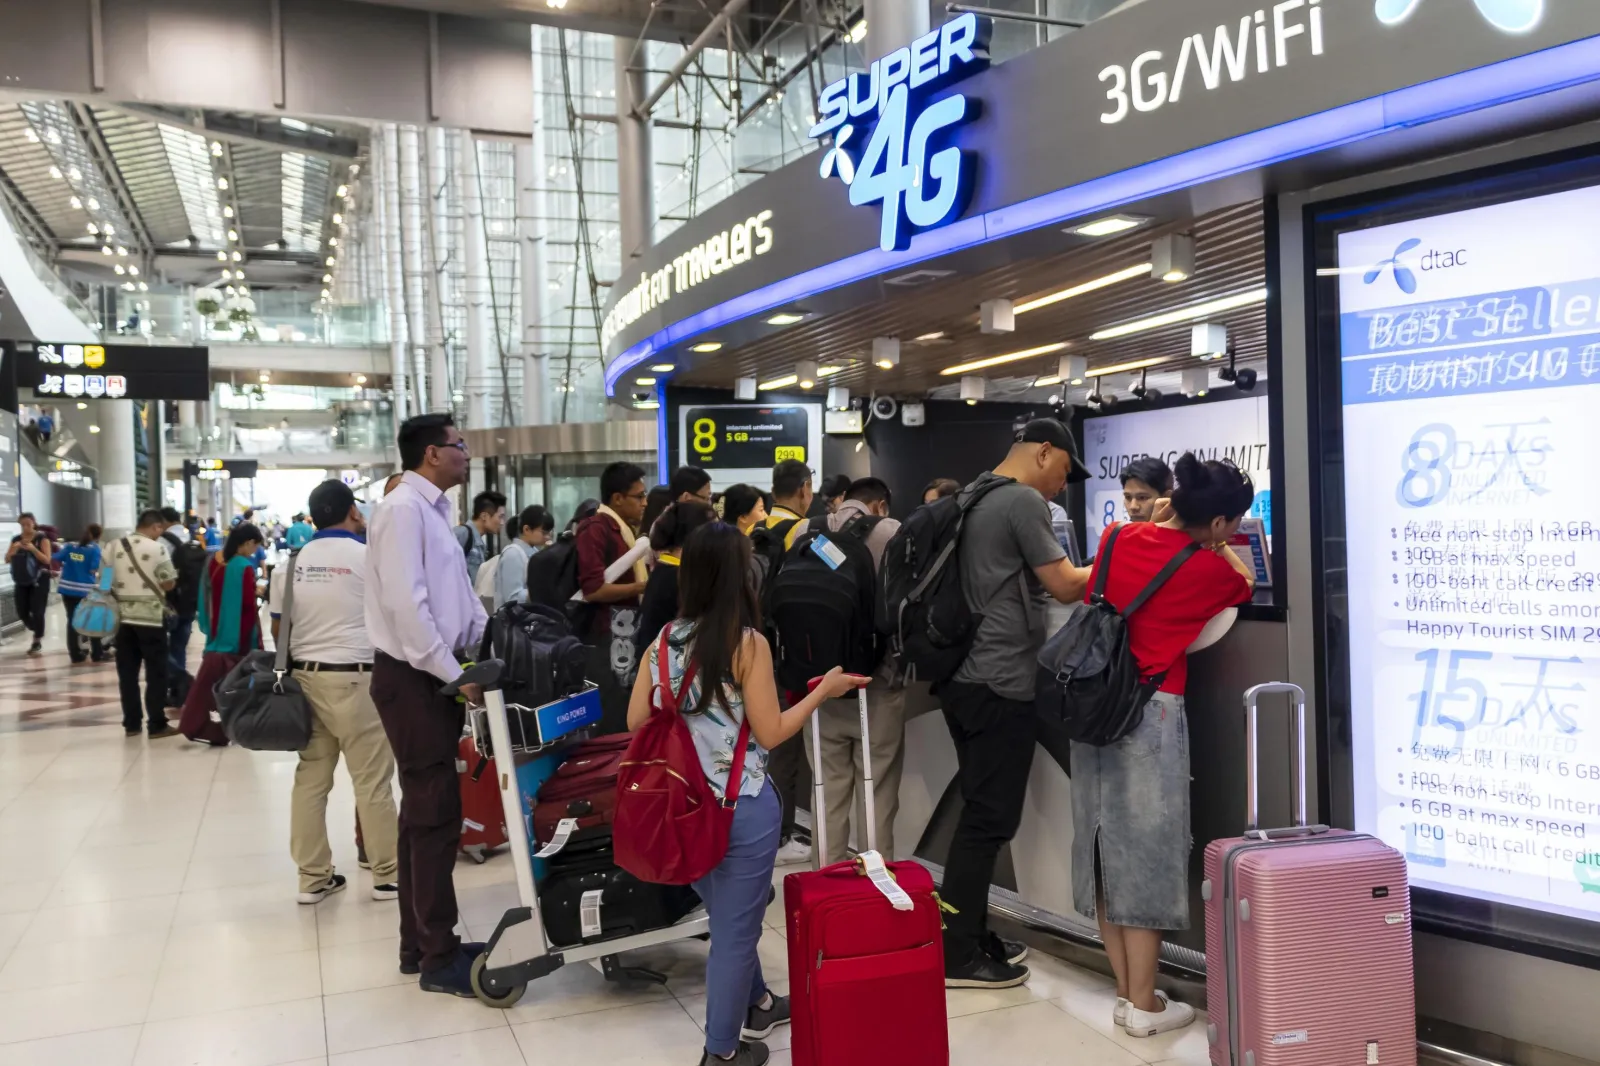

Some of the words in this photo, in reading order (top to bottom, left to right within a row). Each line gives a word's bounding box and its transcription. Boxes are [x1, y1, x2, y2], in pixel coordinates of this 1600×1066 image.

[1098, 0, 1324, 124] 3G/WiFi
[808, 12, 976, 138] SUPER
[849, 83, 966, 251] 4G
[1420, 248, 1467, 271] dtac
[693, 418, 717, 454] 8
[726, 432, 733, 443] 5
[734, 432, 749, 443] GB
[752, 423, 783, 431] unlimited
[1103, 500, 1115, 528] 8
[1472, 553, 1510, 567] max
[1516, 550, 1576, 571] speed
[1498, 601, 1542, 616] calls
[1407, 619, 1464, 640] Happy
[1469, 622, 1534, 641] Tourist
[1540, 625, 1576, 642] SIM
[556, 712, 569, 724] KING
[570, 706, 587, 719] POWER
[1411, 798, 1423, 814] 6
[1428, 801, 1452, 818] GB
[1457, 808, 1475, 821] at
[1481, 812, 1519, 829] max
[1525, 817, 1586, 839] speed
[1413, 821, 1498, 850] 100-baht
[1503, 839, 1536, 856] call
[1542, 846, 1600, 867] credit
